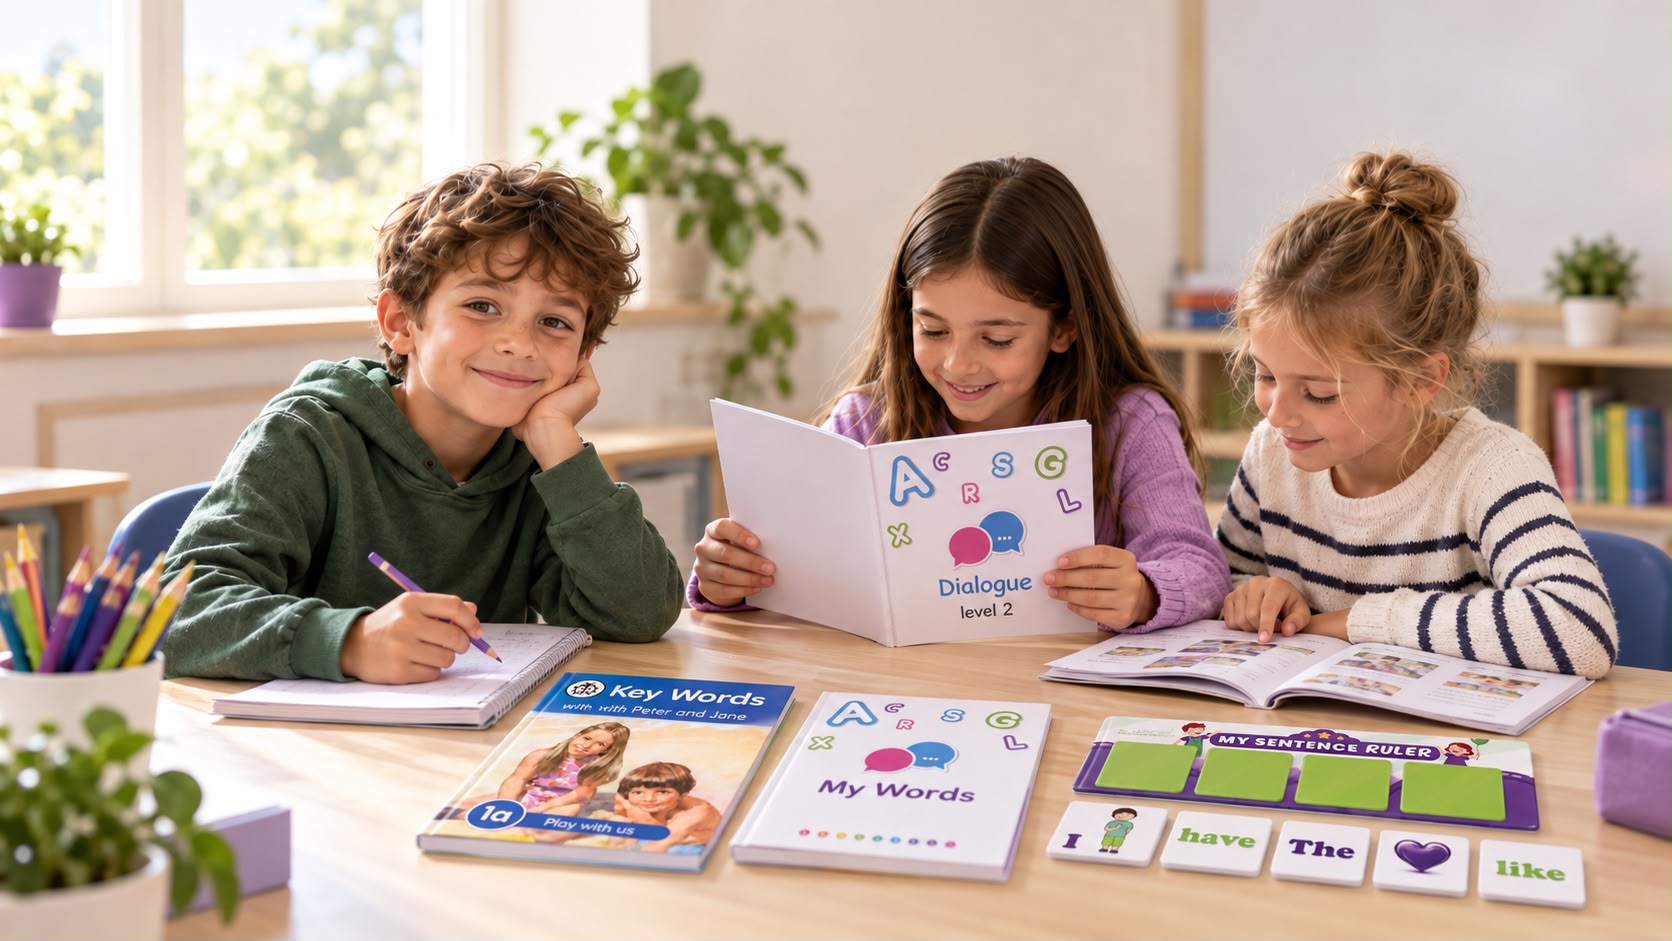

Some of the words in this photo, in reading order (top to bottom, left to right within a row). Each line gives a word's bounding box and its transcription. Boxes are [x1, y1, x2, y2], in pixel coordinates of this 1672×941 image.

[991, 451, 1014, 479] S
[889, 455, 935, 507] A
[961, 482, 980, 505] R
[938, 575, 1033, 598] Dialogue
[960, 603, 997, 619] level
[1002, 602, 1014, 616] 2
[609, 684, 663, 702] Key
[671, 688, 766, 706] Words
[631, 706, 672, 716] Peter
[675, 709, 705, 718] and
[709, 710, 747, 721] Jane
[826, 700, 879, 727] A
[895, 718, 915, 730] R
[940, 708, 966, 723] S
[1218, 735, 1250, 745] MY
[1254, 737, 1358, 753] SENTENCE
[1365, 744, 1432, 758] RULER
[818, 779, 866, 799] My
[876, 782, 976, 803] Words
[480, 805, 513, 823] 1a
[543, 817, 577, 830] Play
[580, 822, 612, 834] with
[616, 826, 636, 836] us
[1061, 833, 1083, 849] I
[1178, 828, 1257, 849] have
[1288, 838, 1356, 860] The
[1496, 859, 1567, 882] like
